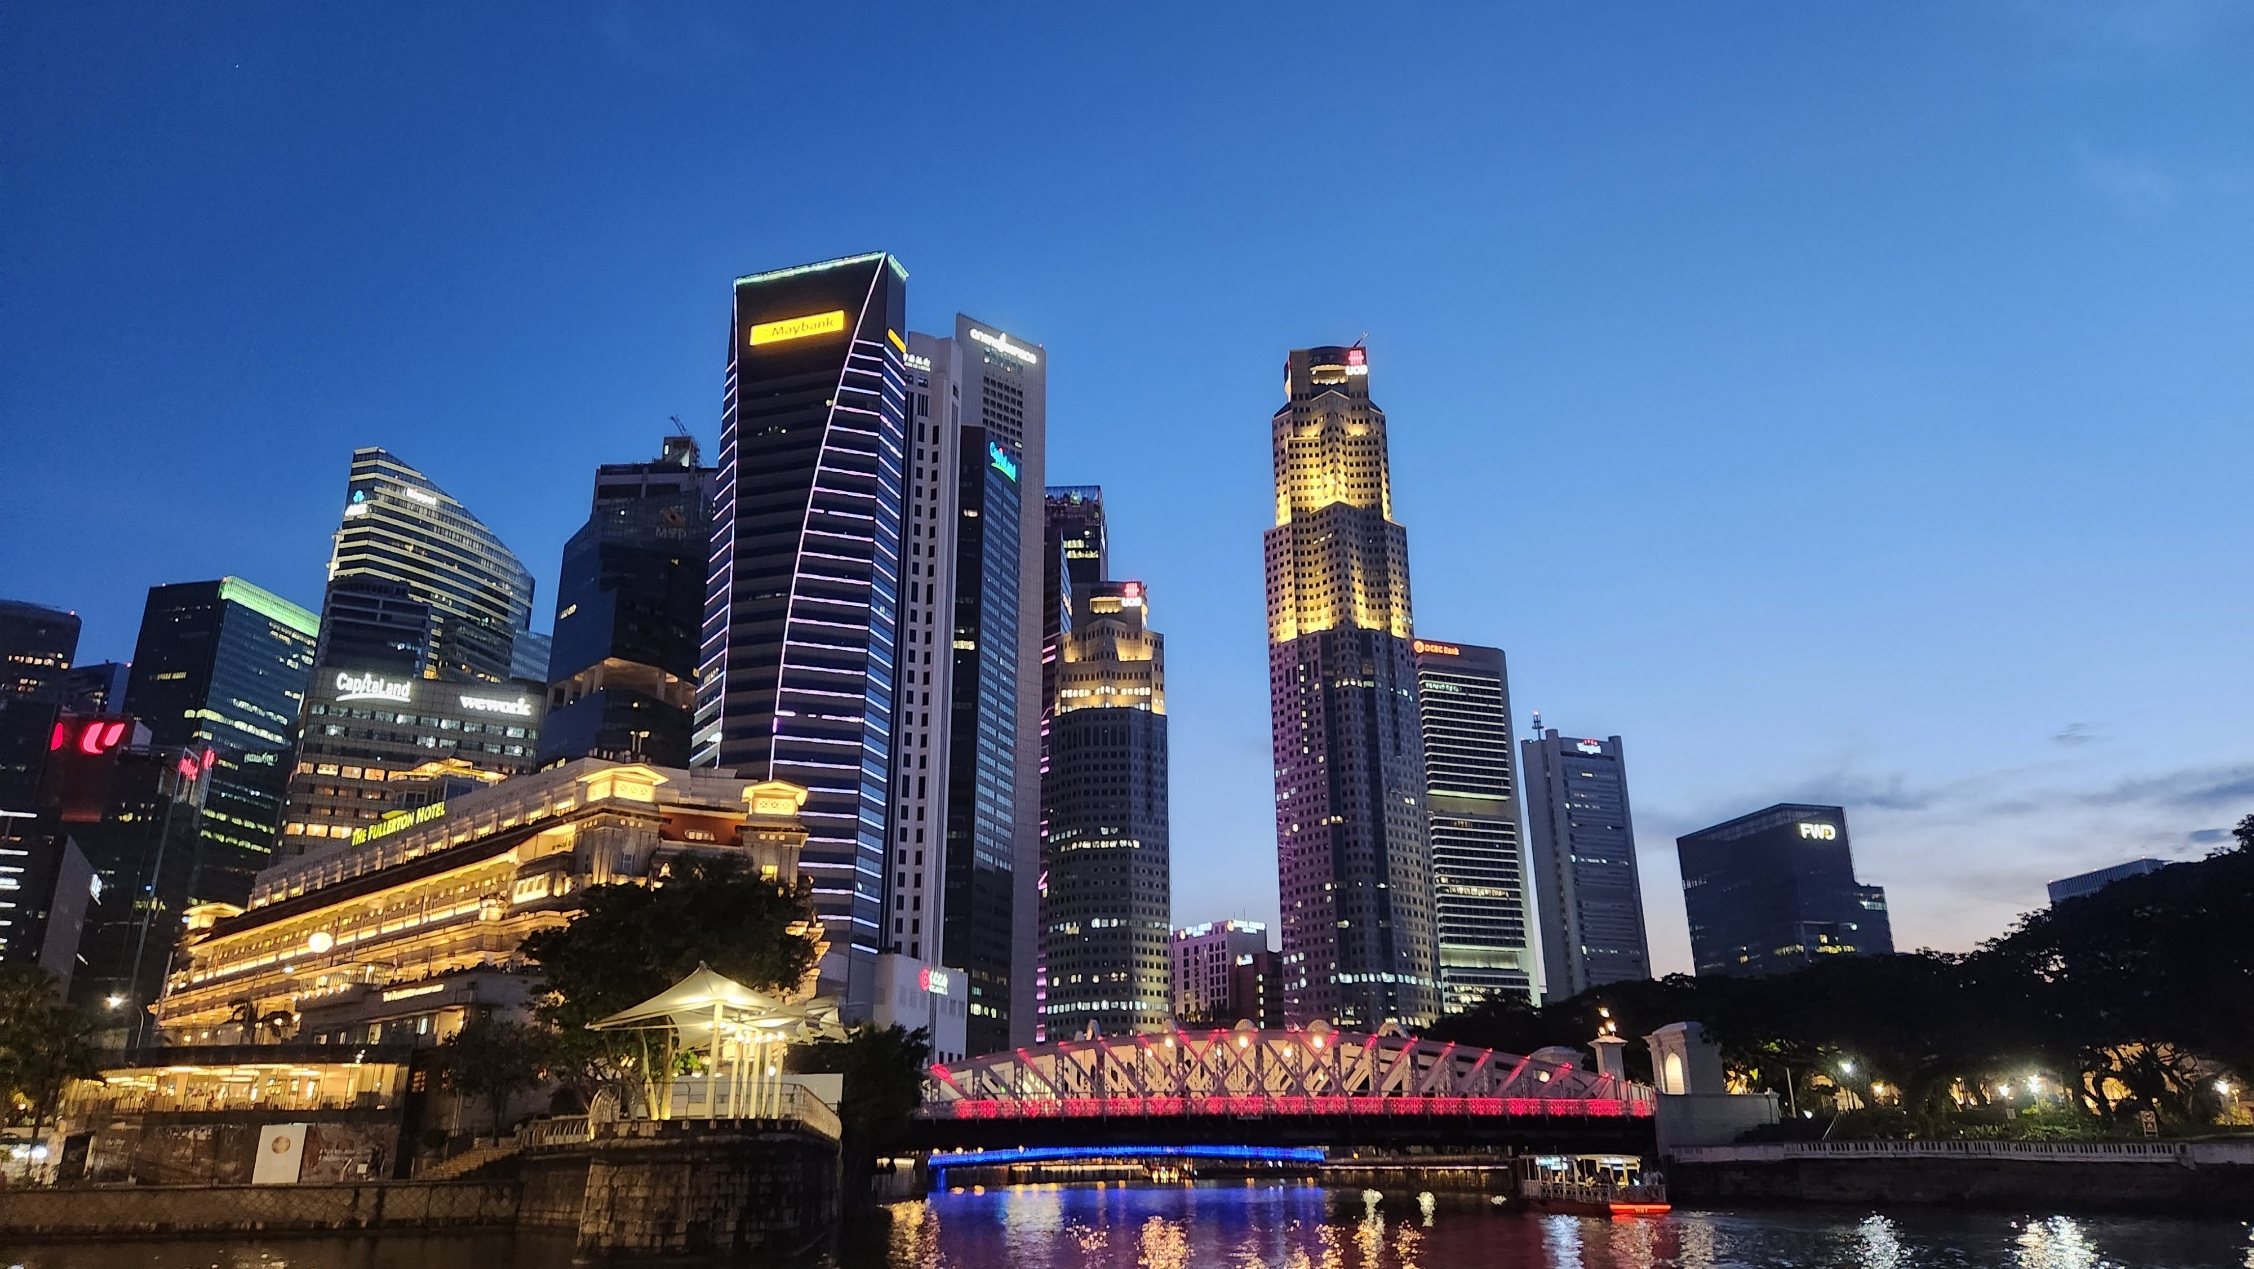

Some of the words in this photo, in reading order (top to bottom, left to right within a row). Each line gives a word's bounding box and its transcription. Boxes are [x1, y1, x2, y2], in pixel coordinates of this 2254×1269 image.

[771, 317, 834, 337] Maybank
[1424, 644, 1443, 653] OCBC
[1443, 646, 1460, 656] Bank
[336, 672, 411, 698] CapitaLand
[459, 695, 532, 716] wework
[351, 829, 367, 847] THE
[367, 812, 415, 841] FULLERTON
[415, 801, 446, 824] HOTEL
[1800, 823, 1836, 840] FWD
